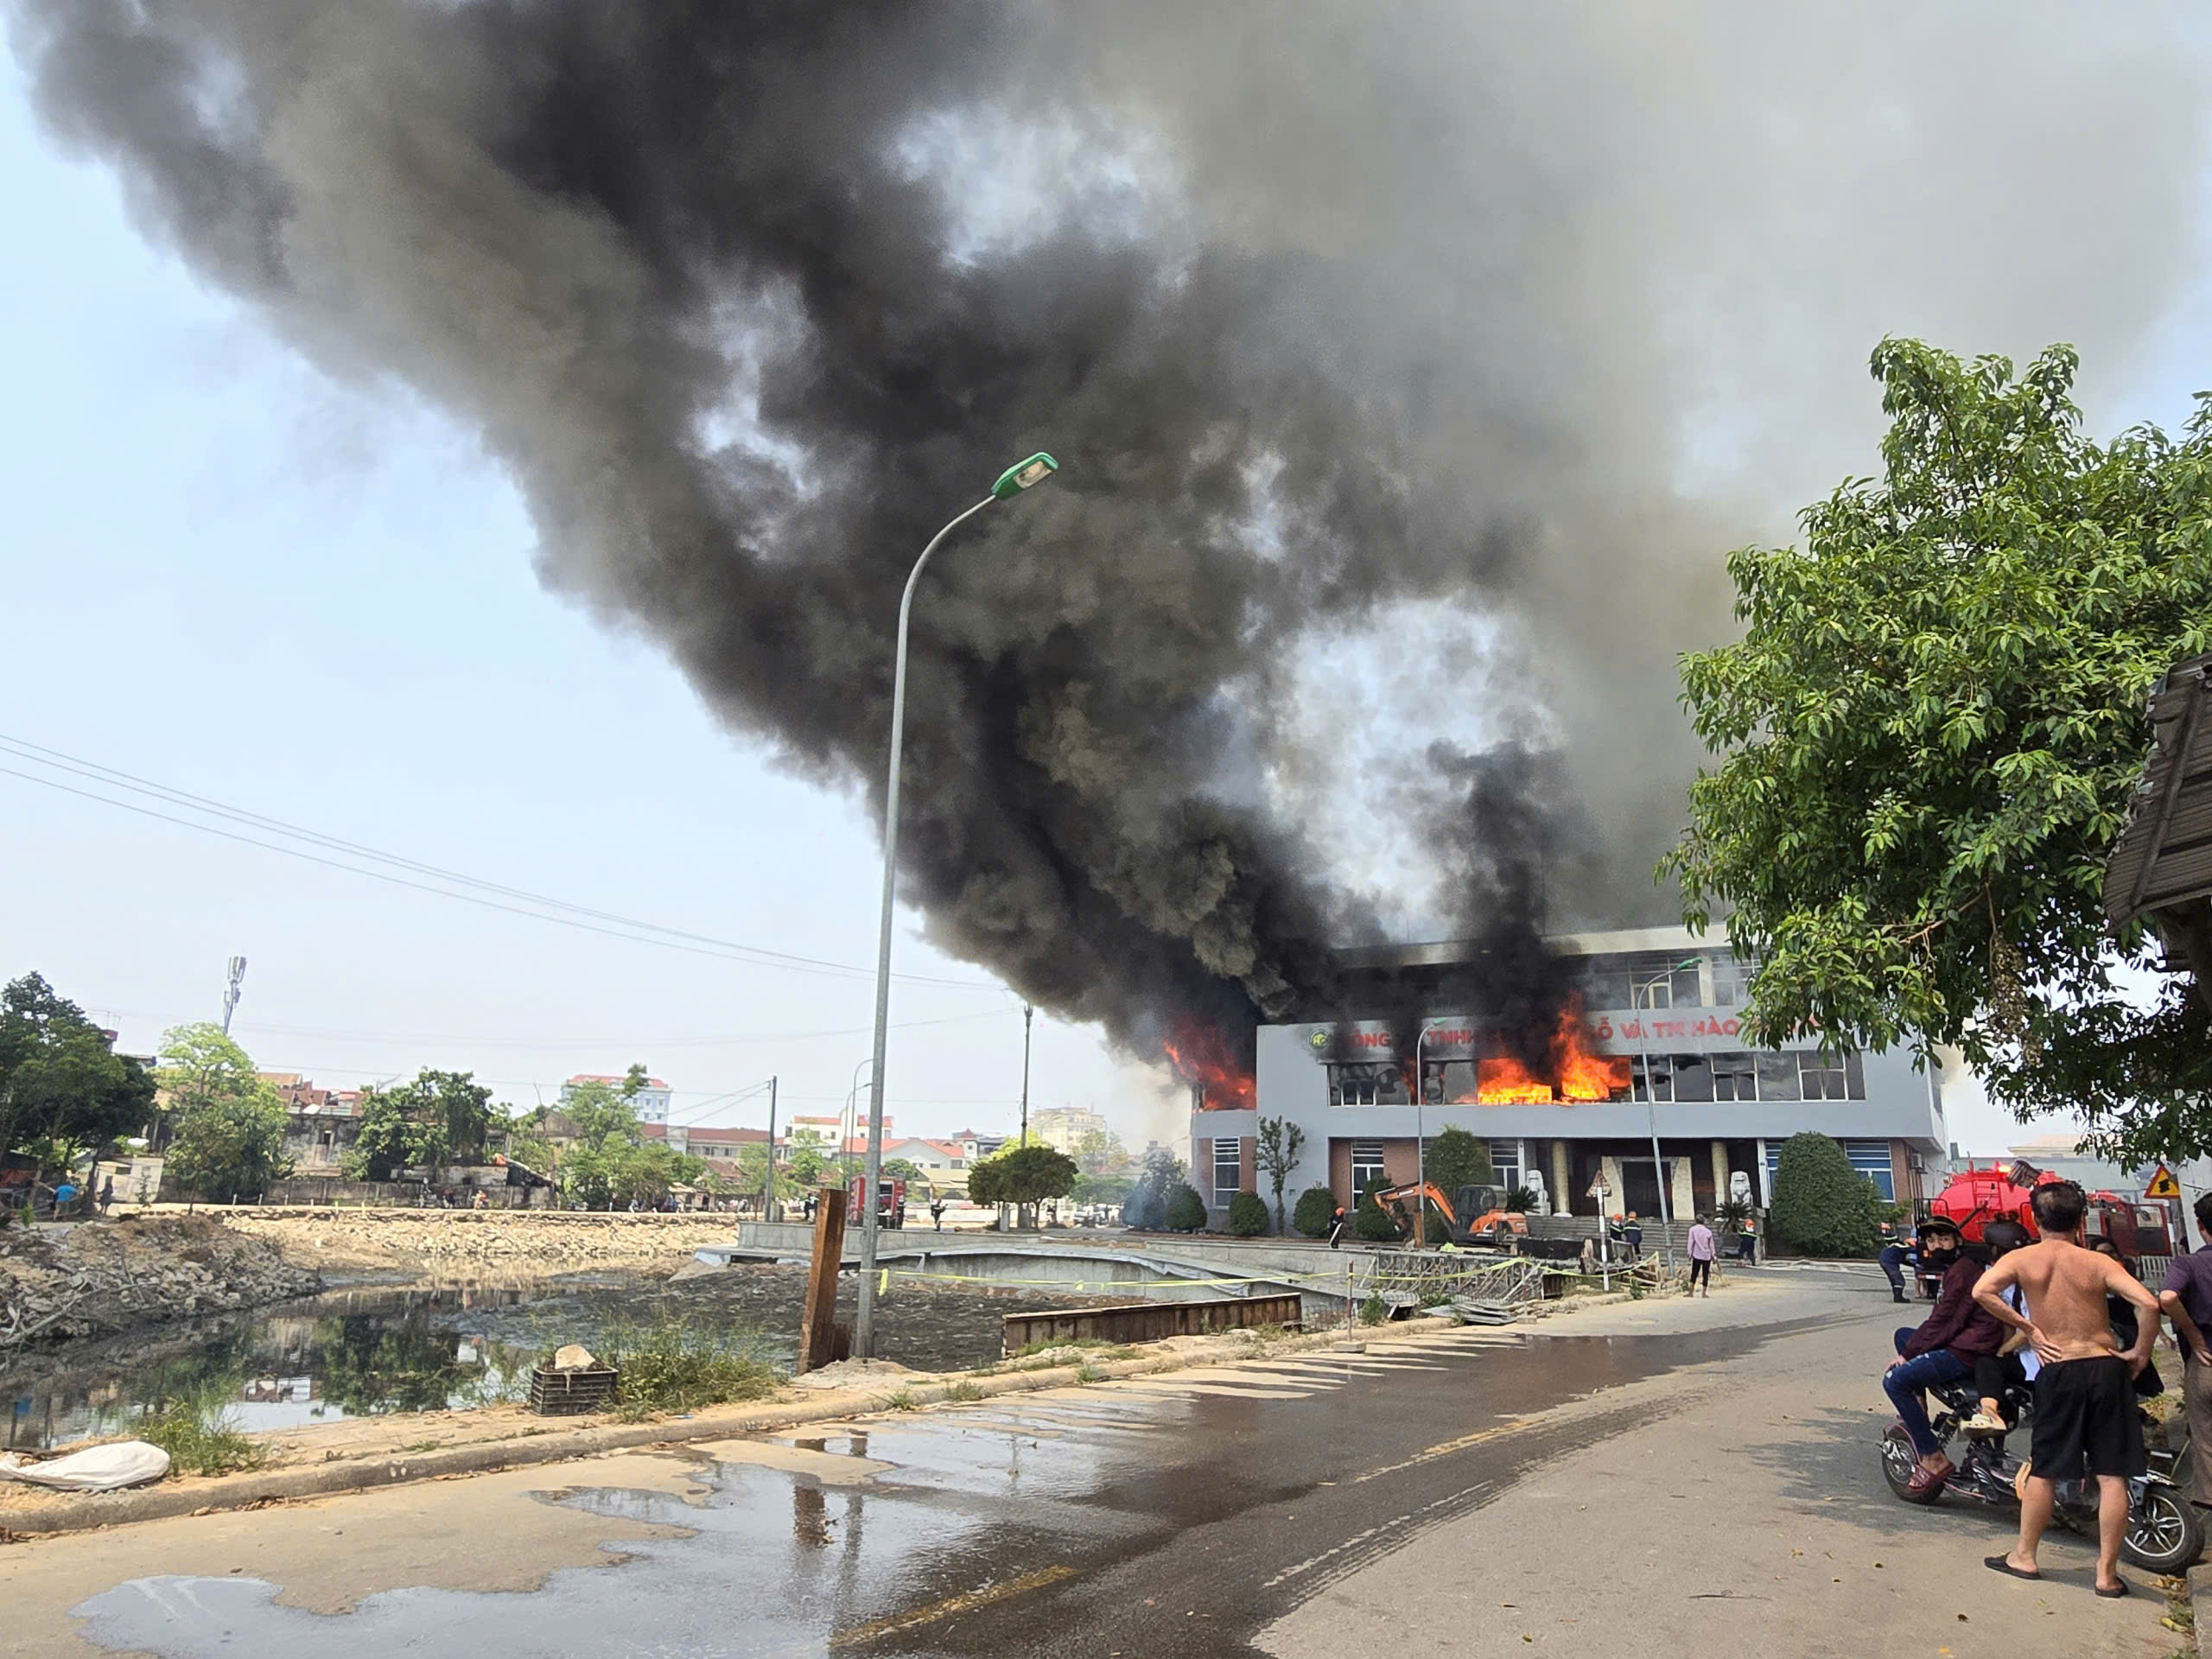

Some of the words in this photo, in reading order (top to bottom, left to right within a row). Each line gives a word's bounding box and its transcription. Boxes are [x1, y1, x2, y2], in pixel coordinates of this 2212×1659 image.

[1341, 1028, 1390, 1047] ÔNG
[1619, 1017, 1648, 1039] VÀ
[1652, 1021, 1685, 1038] TM
[1689, 1014, 1738, 1036] HÀO
